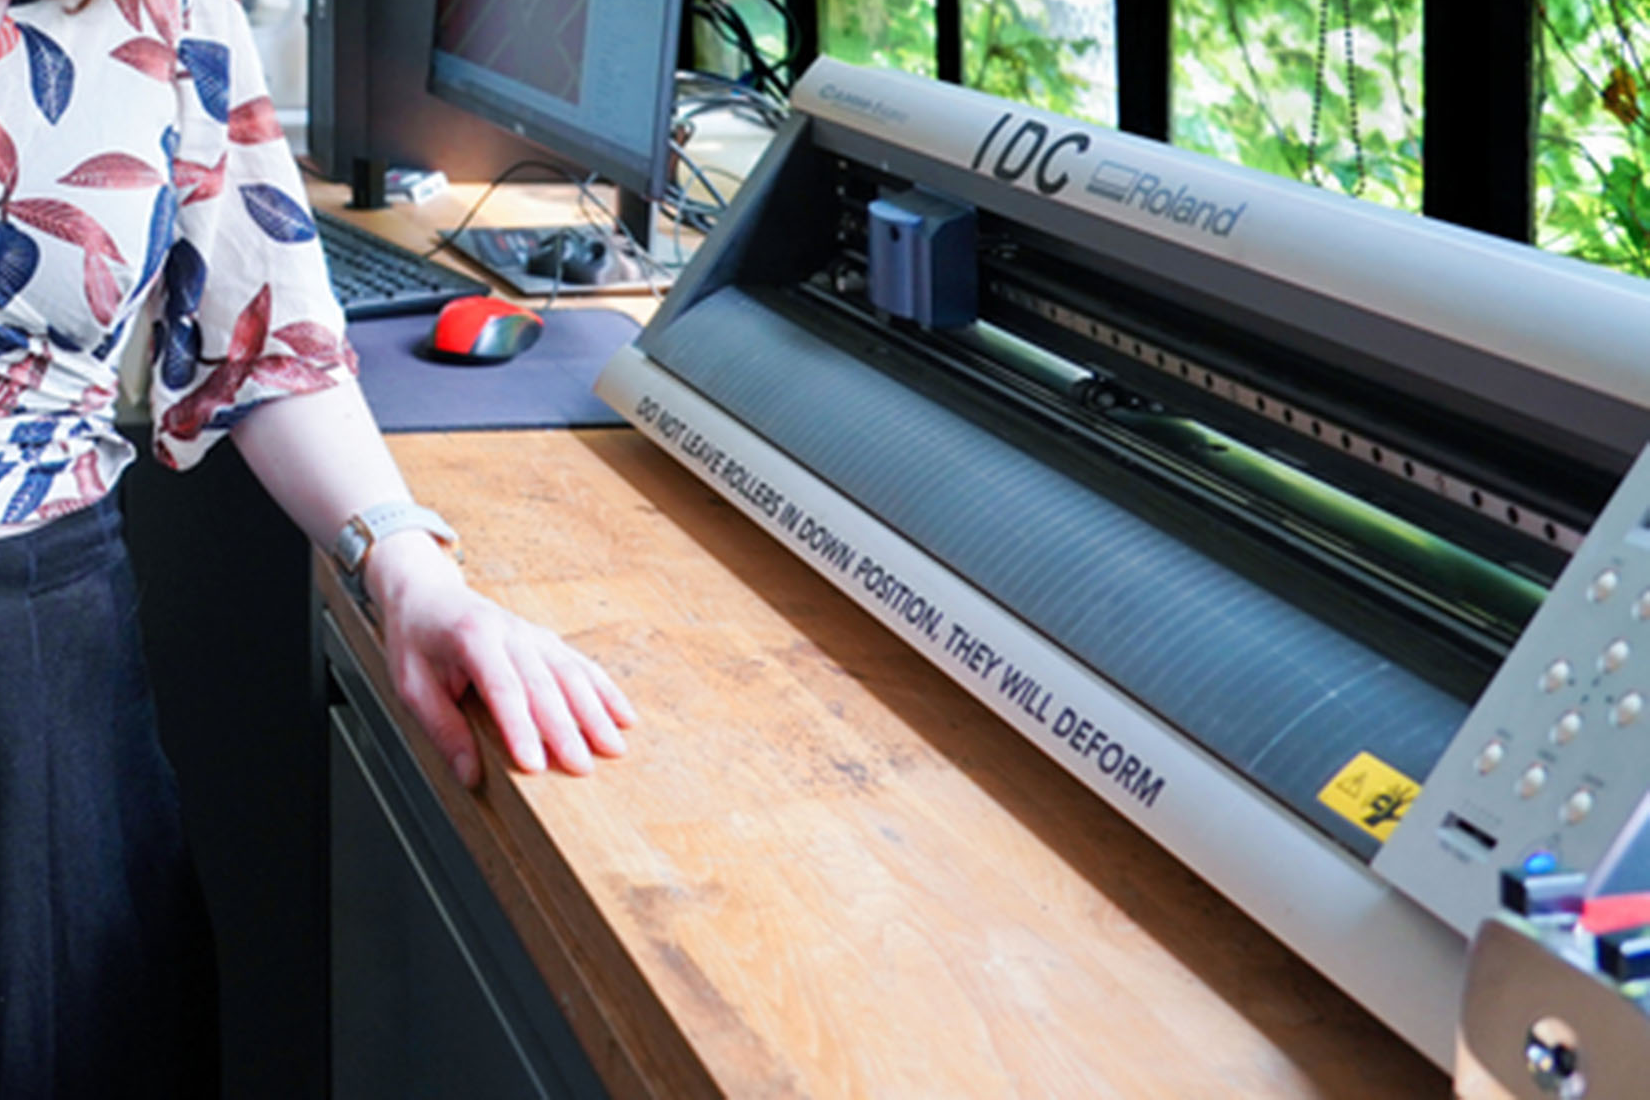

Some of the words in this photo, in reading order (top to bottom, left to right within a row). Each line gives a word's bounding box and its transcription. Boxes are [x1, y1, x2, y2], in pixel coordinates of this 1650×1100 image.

[1124, 173, 1246, 237] Roland
[636, 396, 659, 423] DO
[659, 411, 687, 443] NOT
[681, 430, 727, 474] LEAVE
[721, 459, 784, 518] ROLLERS
[778, 502, 803, 532] IN
[797, 518, 856, 573] DOWN
[945, 623, 1002, 680] THEY
[999, 664, 1053, 724] WILL
[1052, 706, 1166, 808] DEFORM
